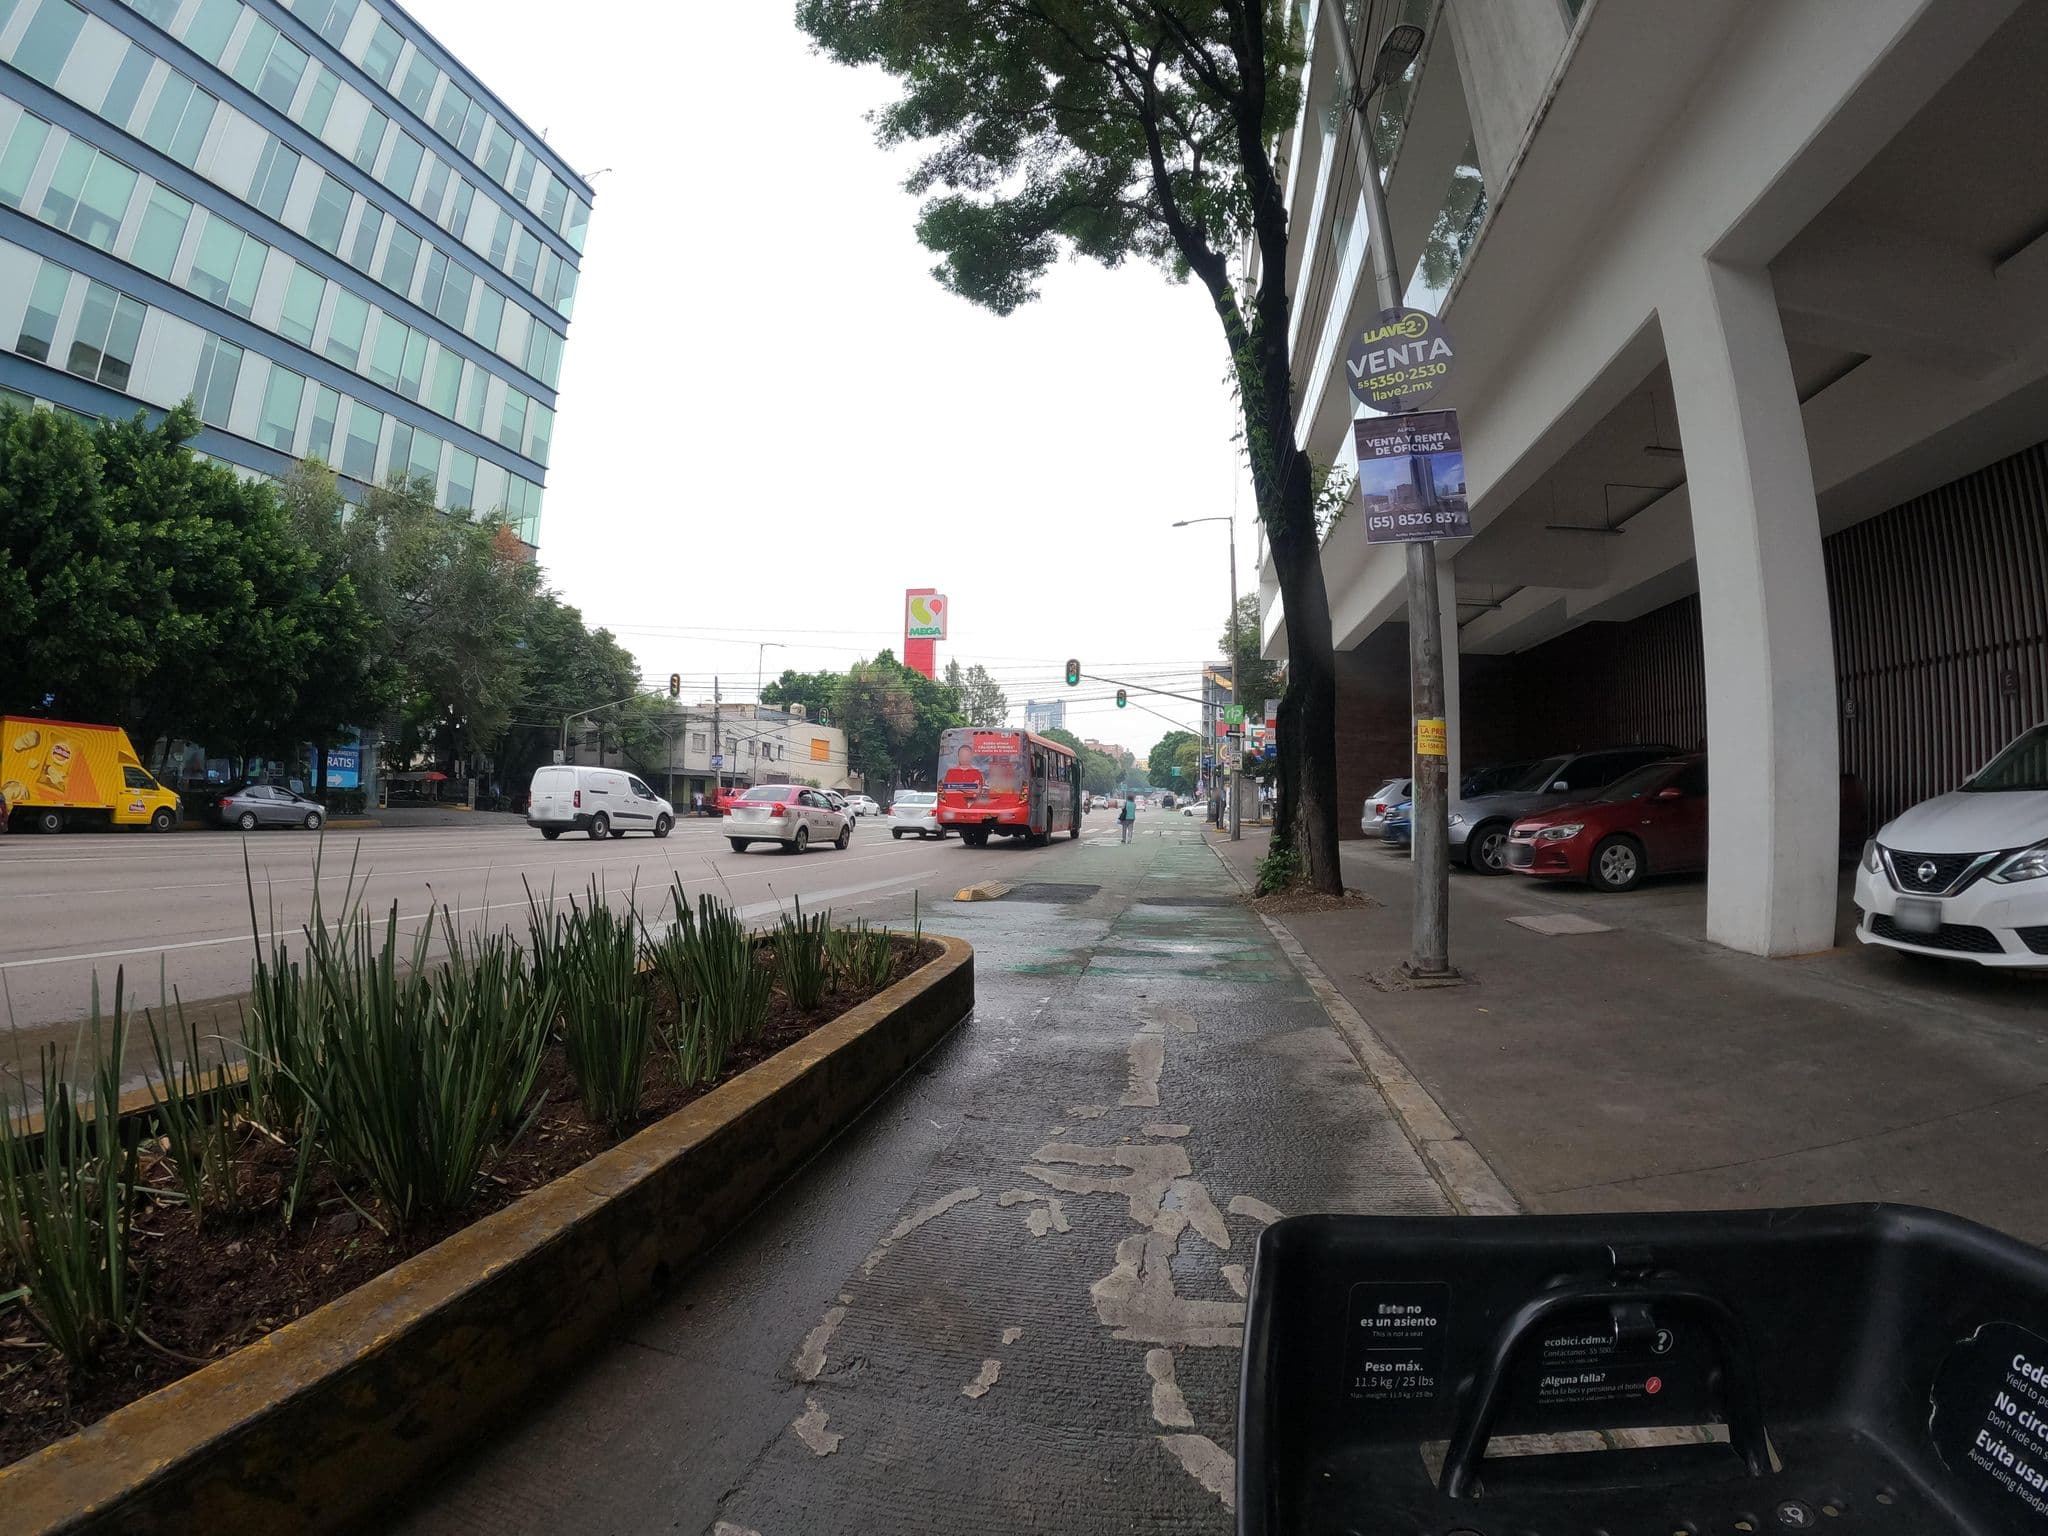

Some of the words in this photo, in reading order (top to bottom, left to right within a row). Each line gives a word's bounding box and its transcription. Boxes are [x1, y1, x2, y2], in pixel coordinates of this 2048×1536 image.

[1363, 320, 1417, 344] LLAVE2
[1346, 337, 1453, 378] VENTA
[1372, 381, 1433, 402] llave2.mx
[1366, 436, 1403, 448] VENTA
[1404, 435, 1412, 443] Y
[1414, 432, 1451, 444] RENTA
[1375, 447, 1391, 456] DE
[1393, 442, 1445, 454] OFICINAS
[1369, 515, 1394, 531] (55)
[1398, 513, 1432, 526] 8526
[909, 627, 941, 636] MEGA
[1407, 1305, 1422, 1314] no
[1360, 1318, 1374, 1327] es
[1376, 1318, 1391, 1327] un
[1393, 1316, 1437, 1327] asiento
[1365, 1361, 1393, 1372] Peso
[1395, 1360, 1424, 1372] máx.
[2012, 1354, 2048, 1389] Cede
[1354, 1377, 1378, 1387] 11.5
[1380, 1377, 1393, 1390] kg
[1394, 1376, 1401, 1389] /
[1402, 1377, 1416, 1387] 25
[1418, 1376, 1434, 1386] lbs
[1540, 1376, 1578, 1387] ¿Alguna
[1580, 1372, 1606, 1384] falla?
[2006, 1371, 2028, 1393] Yield
[2027, 1387, 2038, 1400] to
[1994, 1391, 2017, 1416] No
[1987, 1410, 2012, 1435] Don't
[2011, 1428, 2030, 1447] ride
[2030, 1442, 2043, 1456] on
[1967, 1447, 1994, 1472] Avoid
[1992, 1466, 2017, 1493] using
[1976, 1429, 2015, 1467] Evita
[2015, 1460, 2048, 1493] usar
